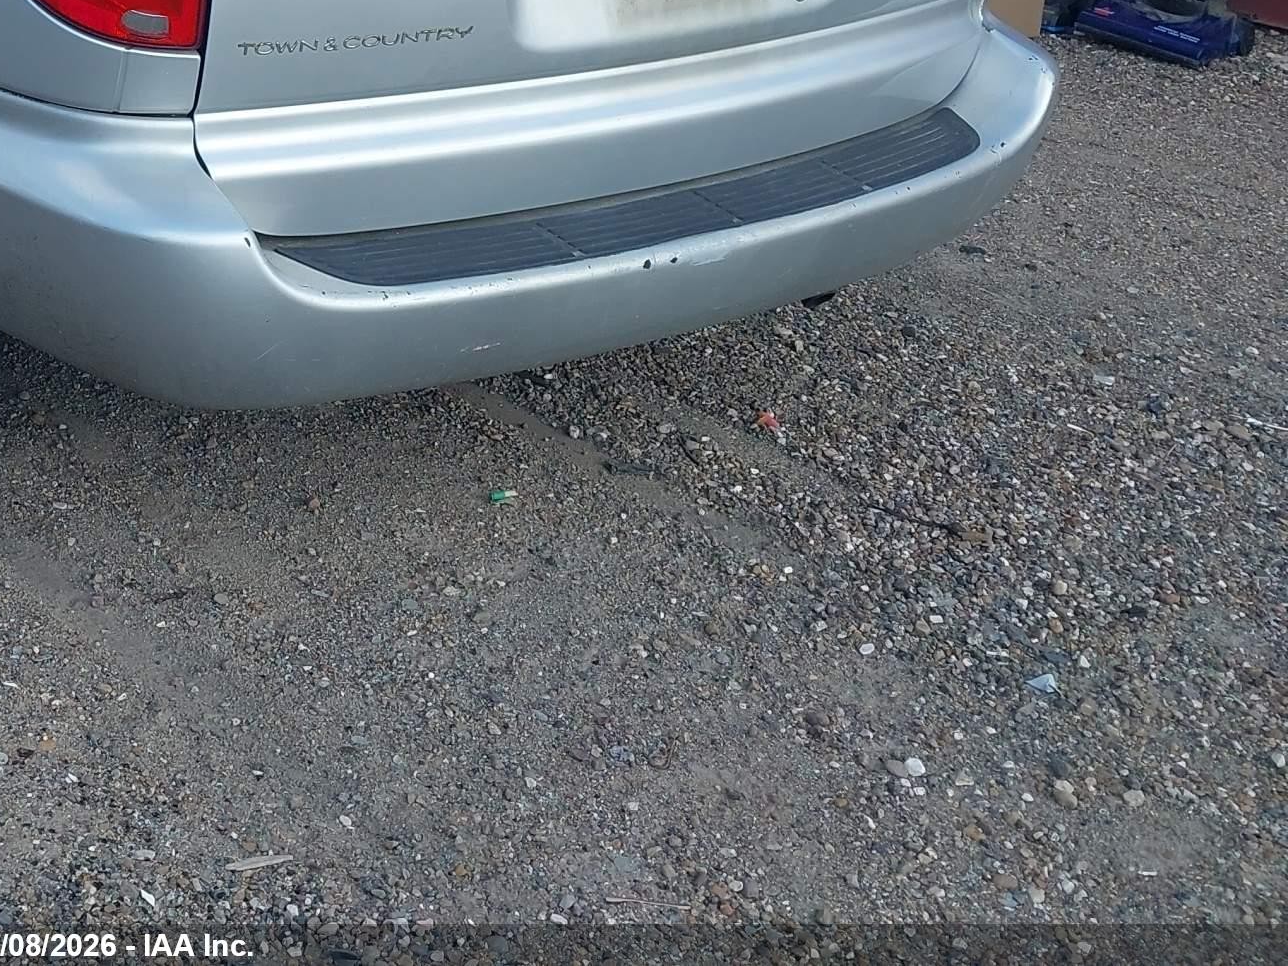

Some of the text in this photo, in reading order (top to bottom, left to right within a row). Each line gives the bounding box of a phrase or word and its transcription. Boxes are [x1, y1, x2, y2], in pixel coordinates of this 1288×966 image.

[237, 25, 475, 56] TOWN & COUNTRY
